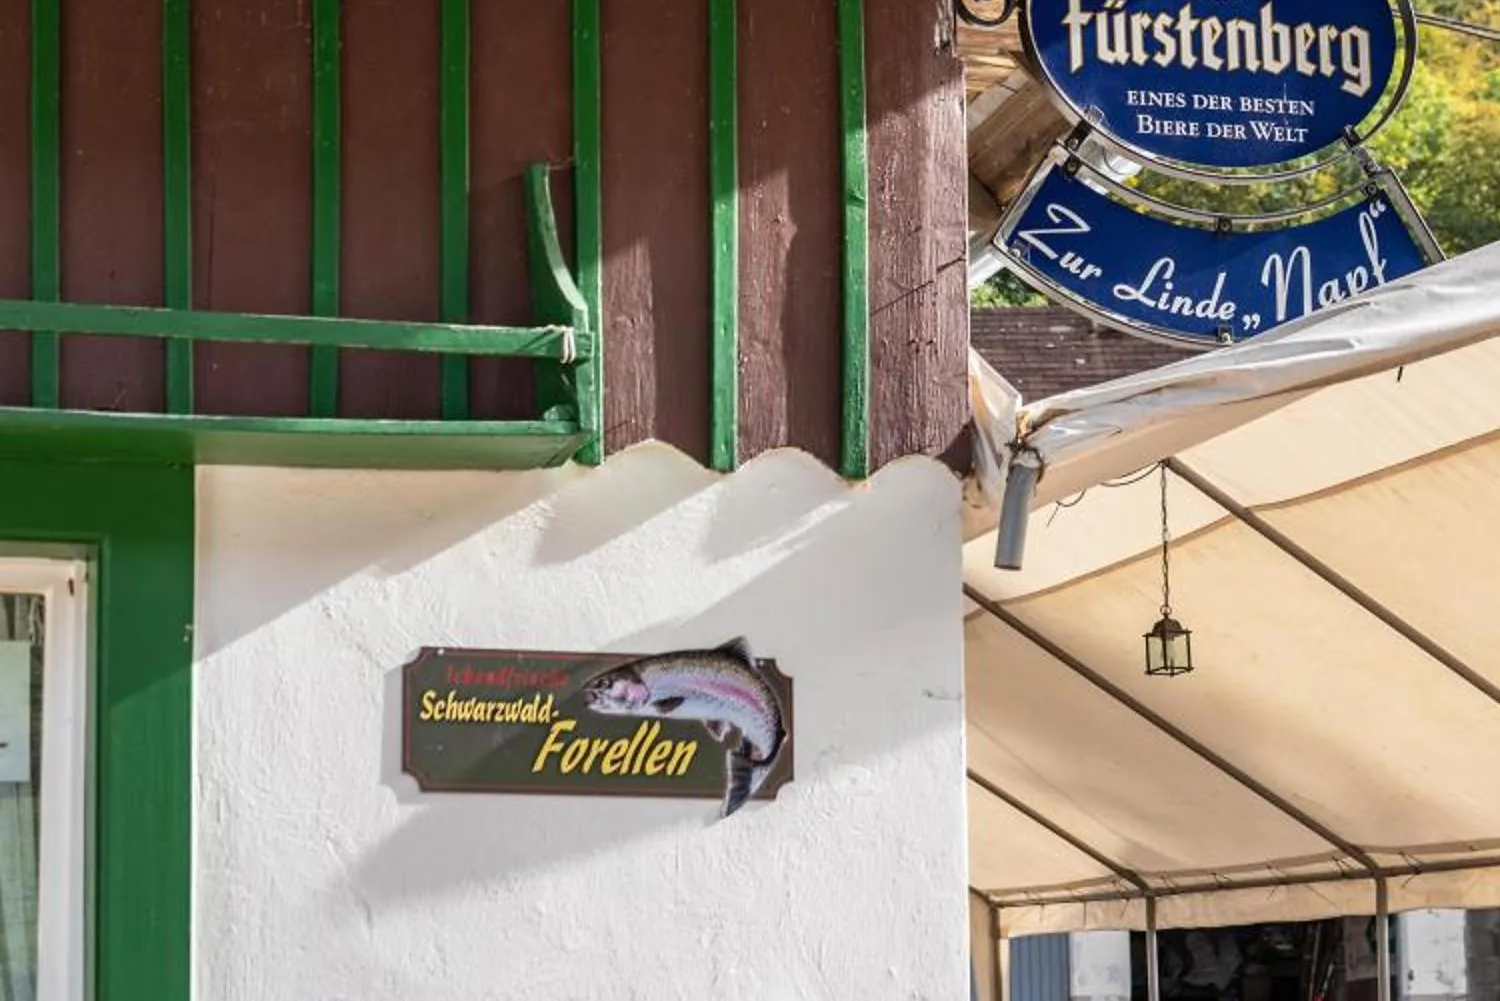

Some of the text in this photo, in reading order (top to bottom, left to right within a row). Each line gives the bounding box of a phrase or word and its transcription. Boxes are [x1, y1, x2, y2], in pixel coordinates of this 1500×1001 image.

[1127, 89, 1315, 117] EINES DER BESTEN
[1206, 121, 1247, 140] DER
[1018, 202, 1102, 281] Zur
[1113, 256, 1235, 322] Linde
[420, 689, 559, 724] Schwarzwald-
[531, 719, 698, 777] Forellen
